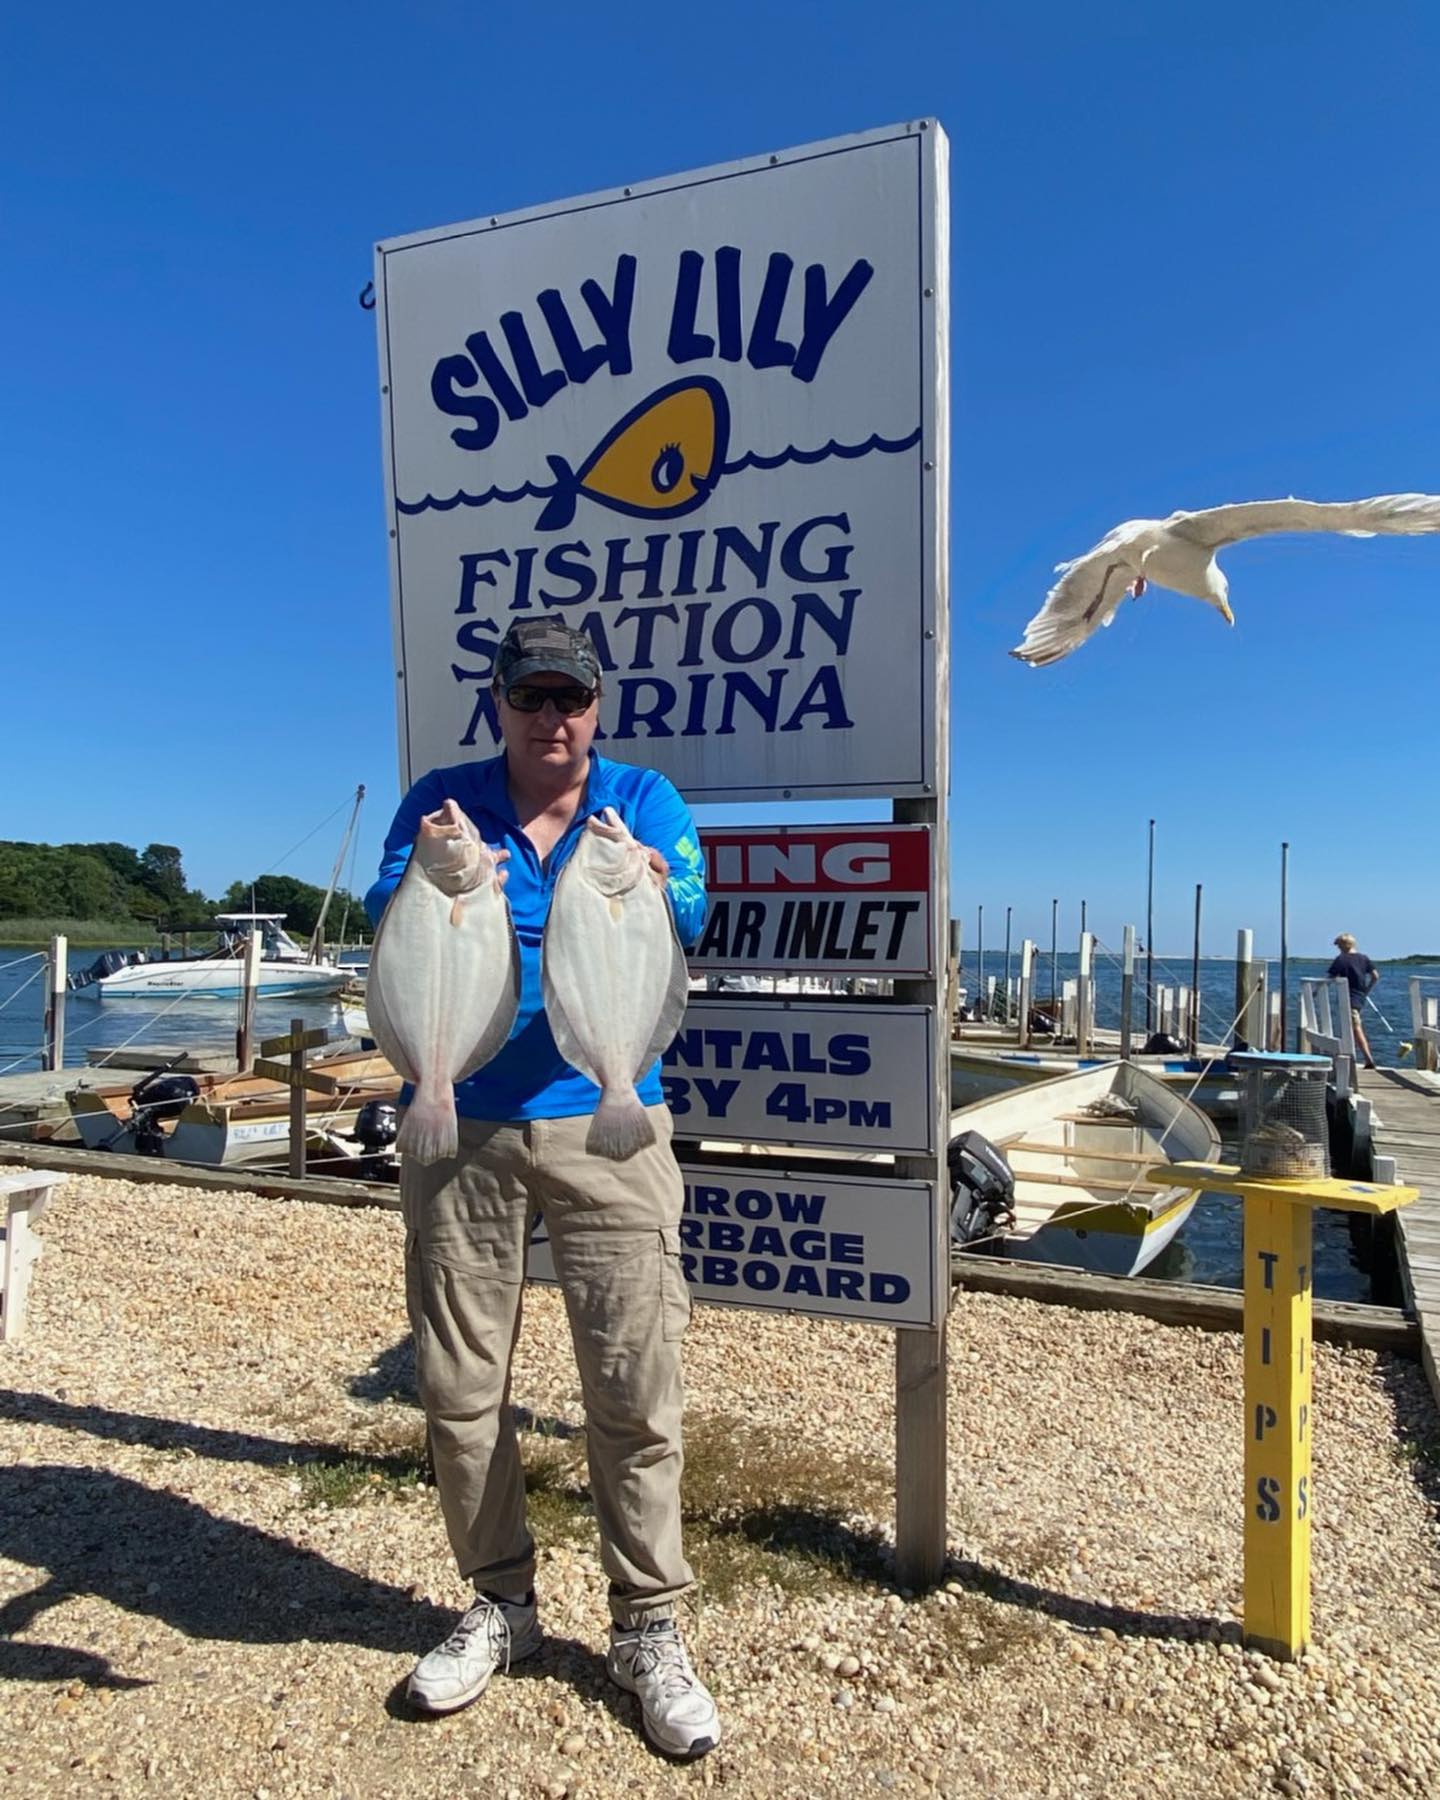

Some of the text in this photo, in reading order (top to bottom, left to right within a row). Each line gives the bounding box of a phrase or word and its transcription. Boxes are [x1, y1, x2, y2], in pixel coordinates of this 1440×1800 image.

[431, 245, 875, 451] SILLY LILY
[454, 512, 856, 615] FISHING
[451, 588, 863, 682] SATION
[459, 664, 855, 747] MRINA
[685, 901, 920, 960] AR INLET
